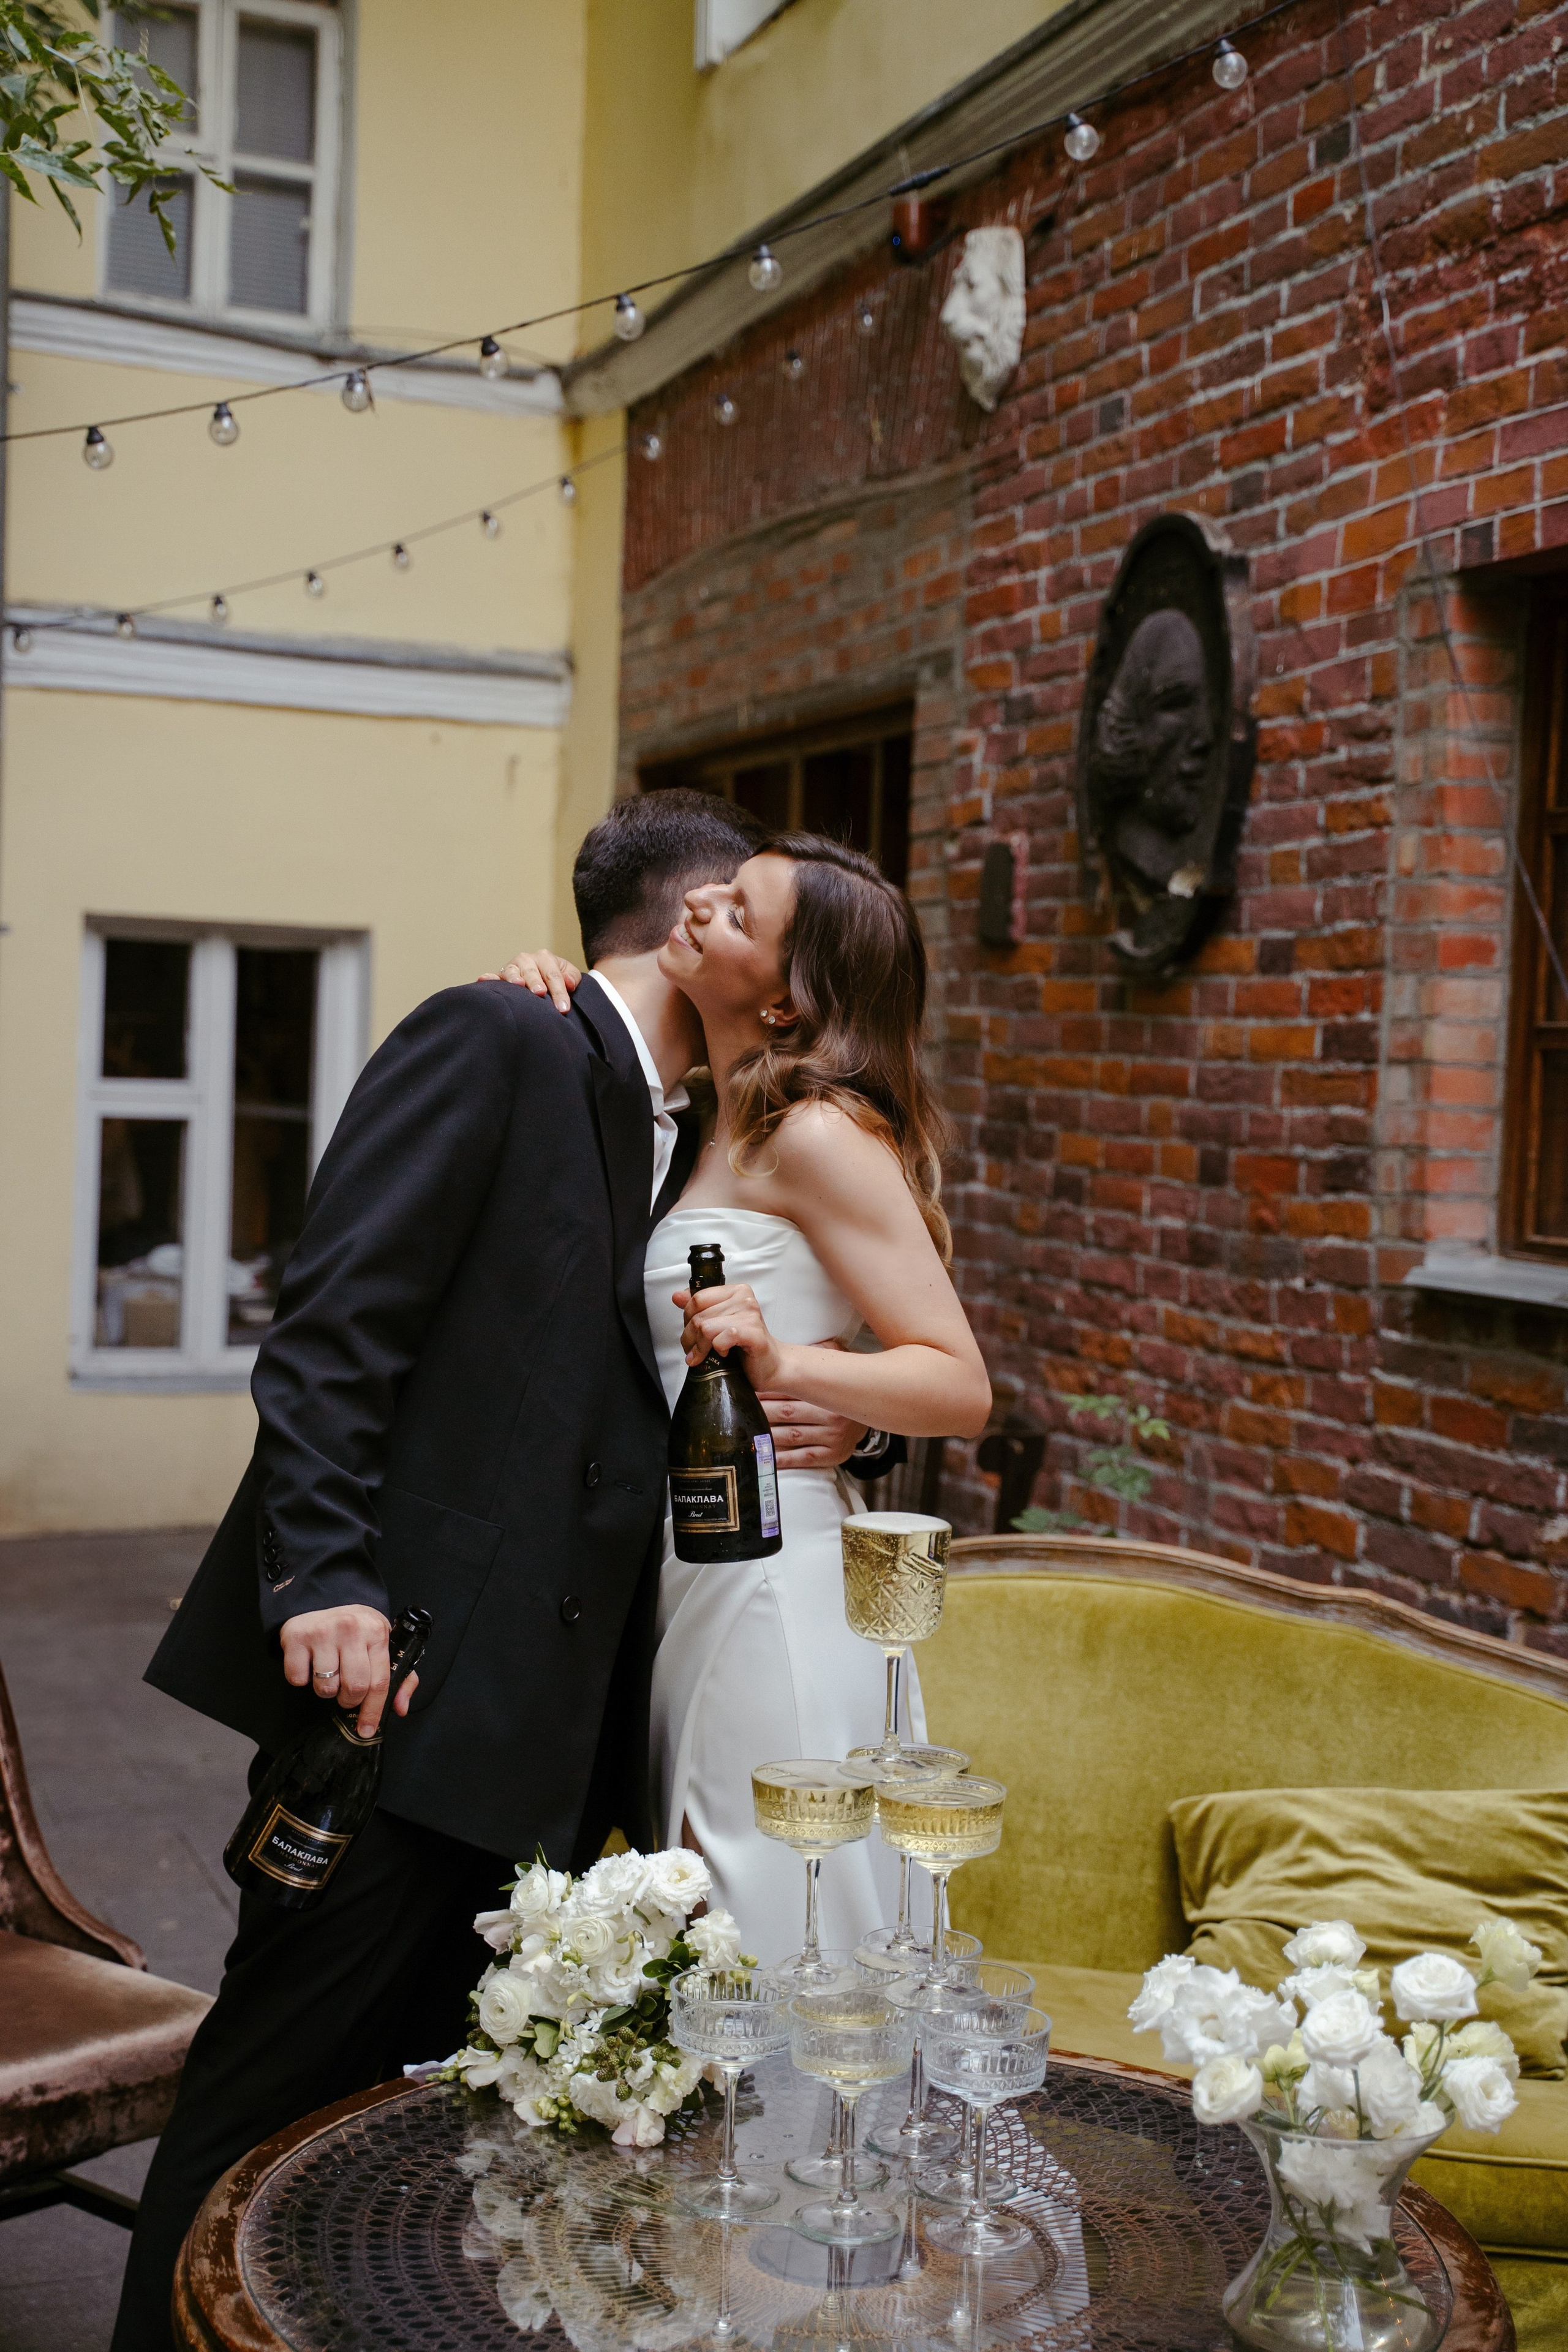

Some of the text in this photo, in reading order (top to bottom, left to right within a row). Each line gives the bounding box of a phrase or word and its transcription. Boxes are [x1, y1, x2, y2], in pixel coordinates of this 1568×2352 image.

[674, 1494, 724, 1503] БАЛАКЛАВА
[271, 1836, 328, 1865] БАЛАКЛАВА
[284, 1863, 303, 1872] Brut
